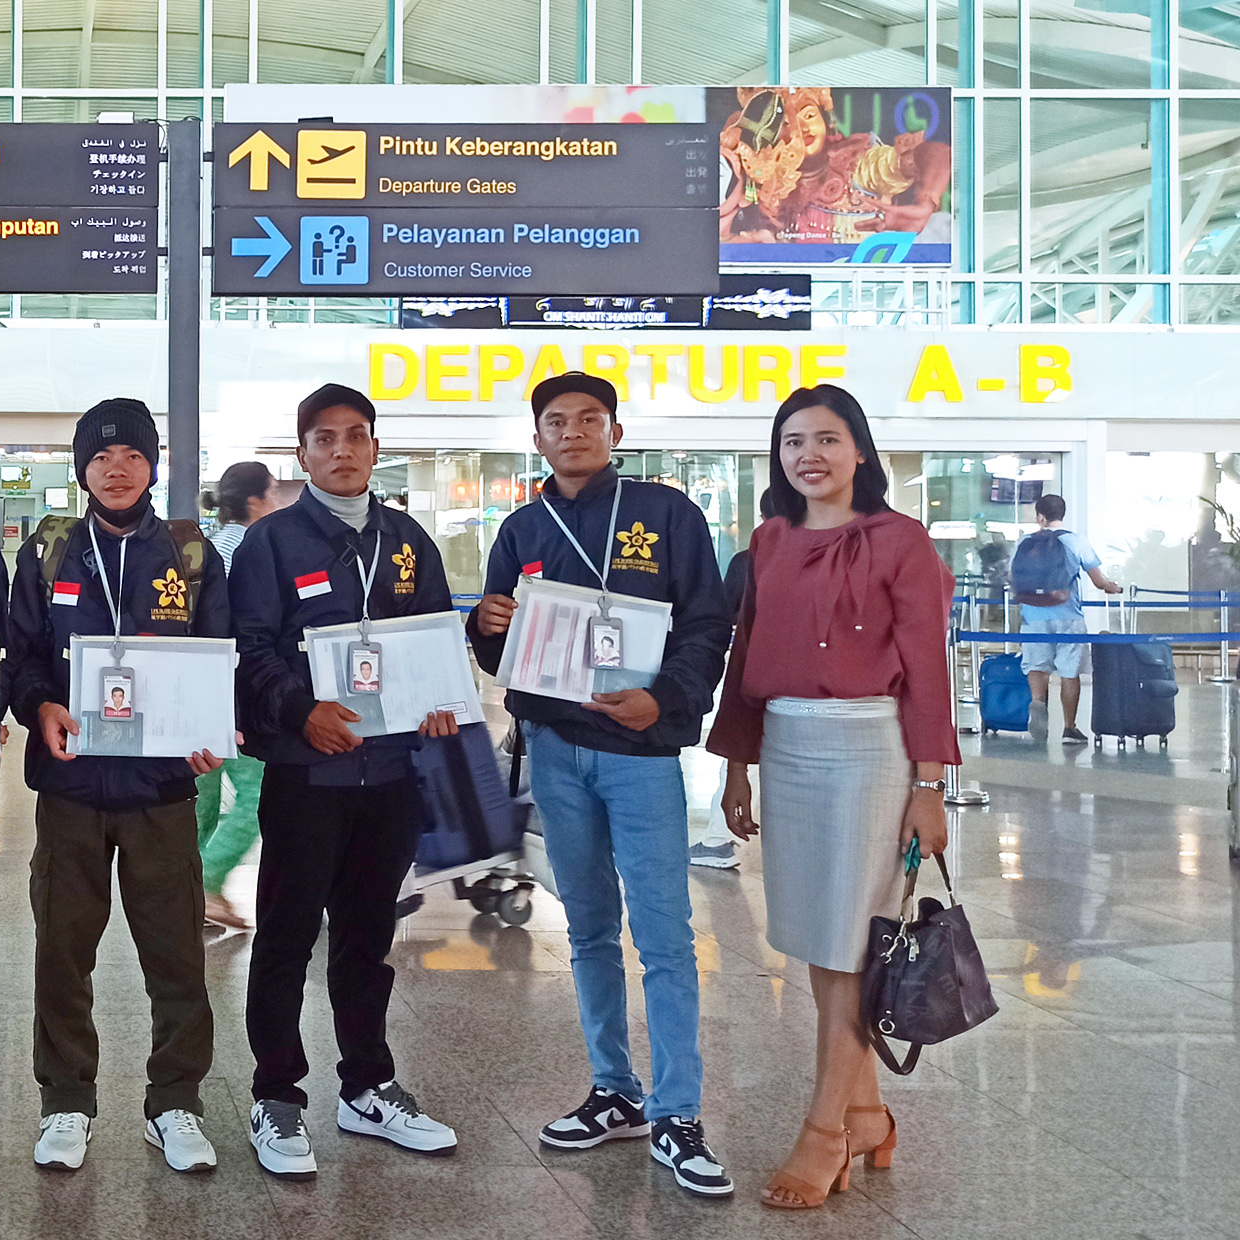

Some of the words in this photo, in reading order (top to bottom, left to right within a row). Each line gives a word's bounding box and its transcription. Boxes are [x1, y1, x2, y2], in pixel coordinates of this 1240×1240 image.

[379, 135, 440, 157] Pintu
[445, 135, 618, 161] Keberangkatan
[92, 169, 146, 179] チェックイン
[379, 177, 462, 197] Departure
[468, 178, 517, 195] Gates
[382, 222, 507, 250] Pelayanan
[513, 222, 640, 250] Pelanggan
[781, 231, 805, 240] Topeng
[806, 231, 827, 239] Dance
[383, 261, 464, 279] Customer
[469, 261, 533, 279] Service
[368, 342, 848, 404] DEPARTURE
